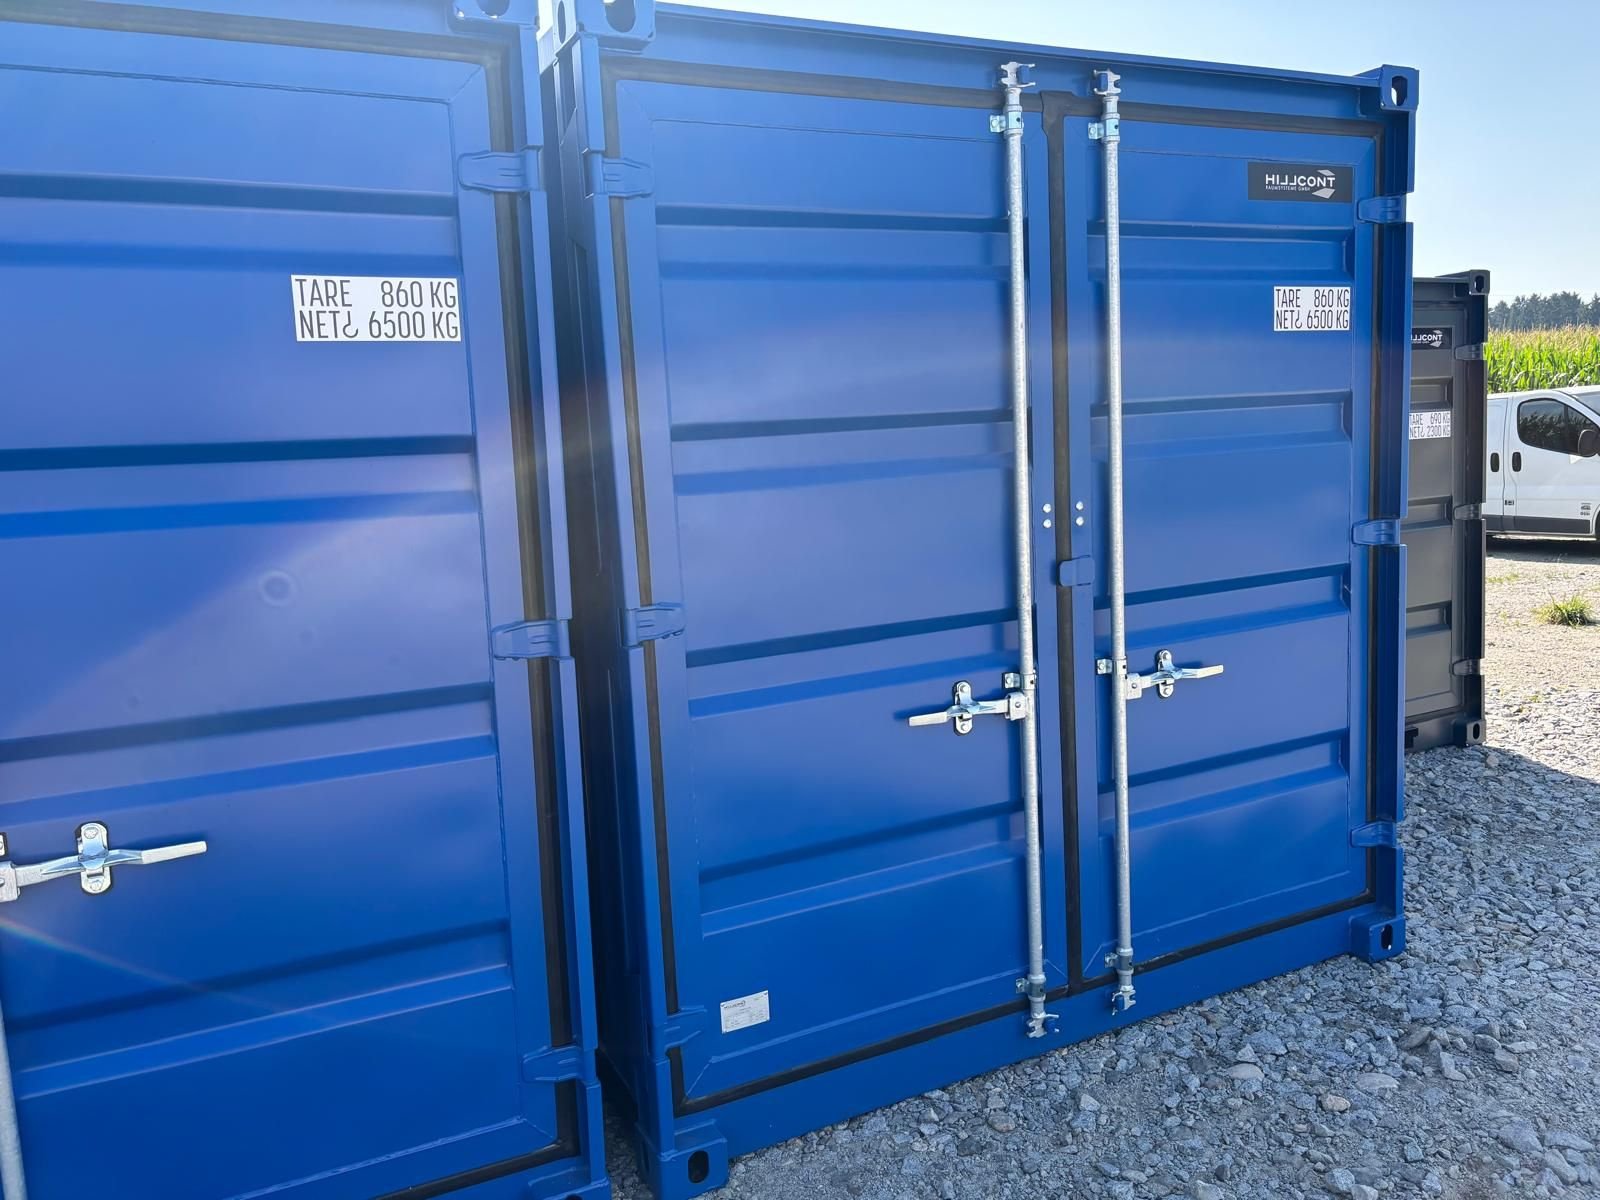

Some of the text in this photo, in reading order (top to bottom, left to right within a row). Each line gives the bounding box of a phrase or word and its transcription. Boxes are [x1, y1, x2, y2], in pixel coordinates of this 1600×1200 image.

[294, 278, 457, 308] TARE 860 KG
[1275, 289, 1350, 308] TARE 860 KG
[368, 311, 426, 339] 6500
[432, 311, 459, 339] KG
[1306, 310, 1334, 329] 6500
[1336, 310, 1349, 329] KG
